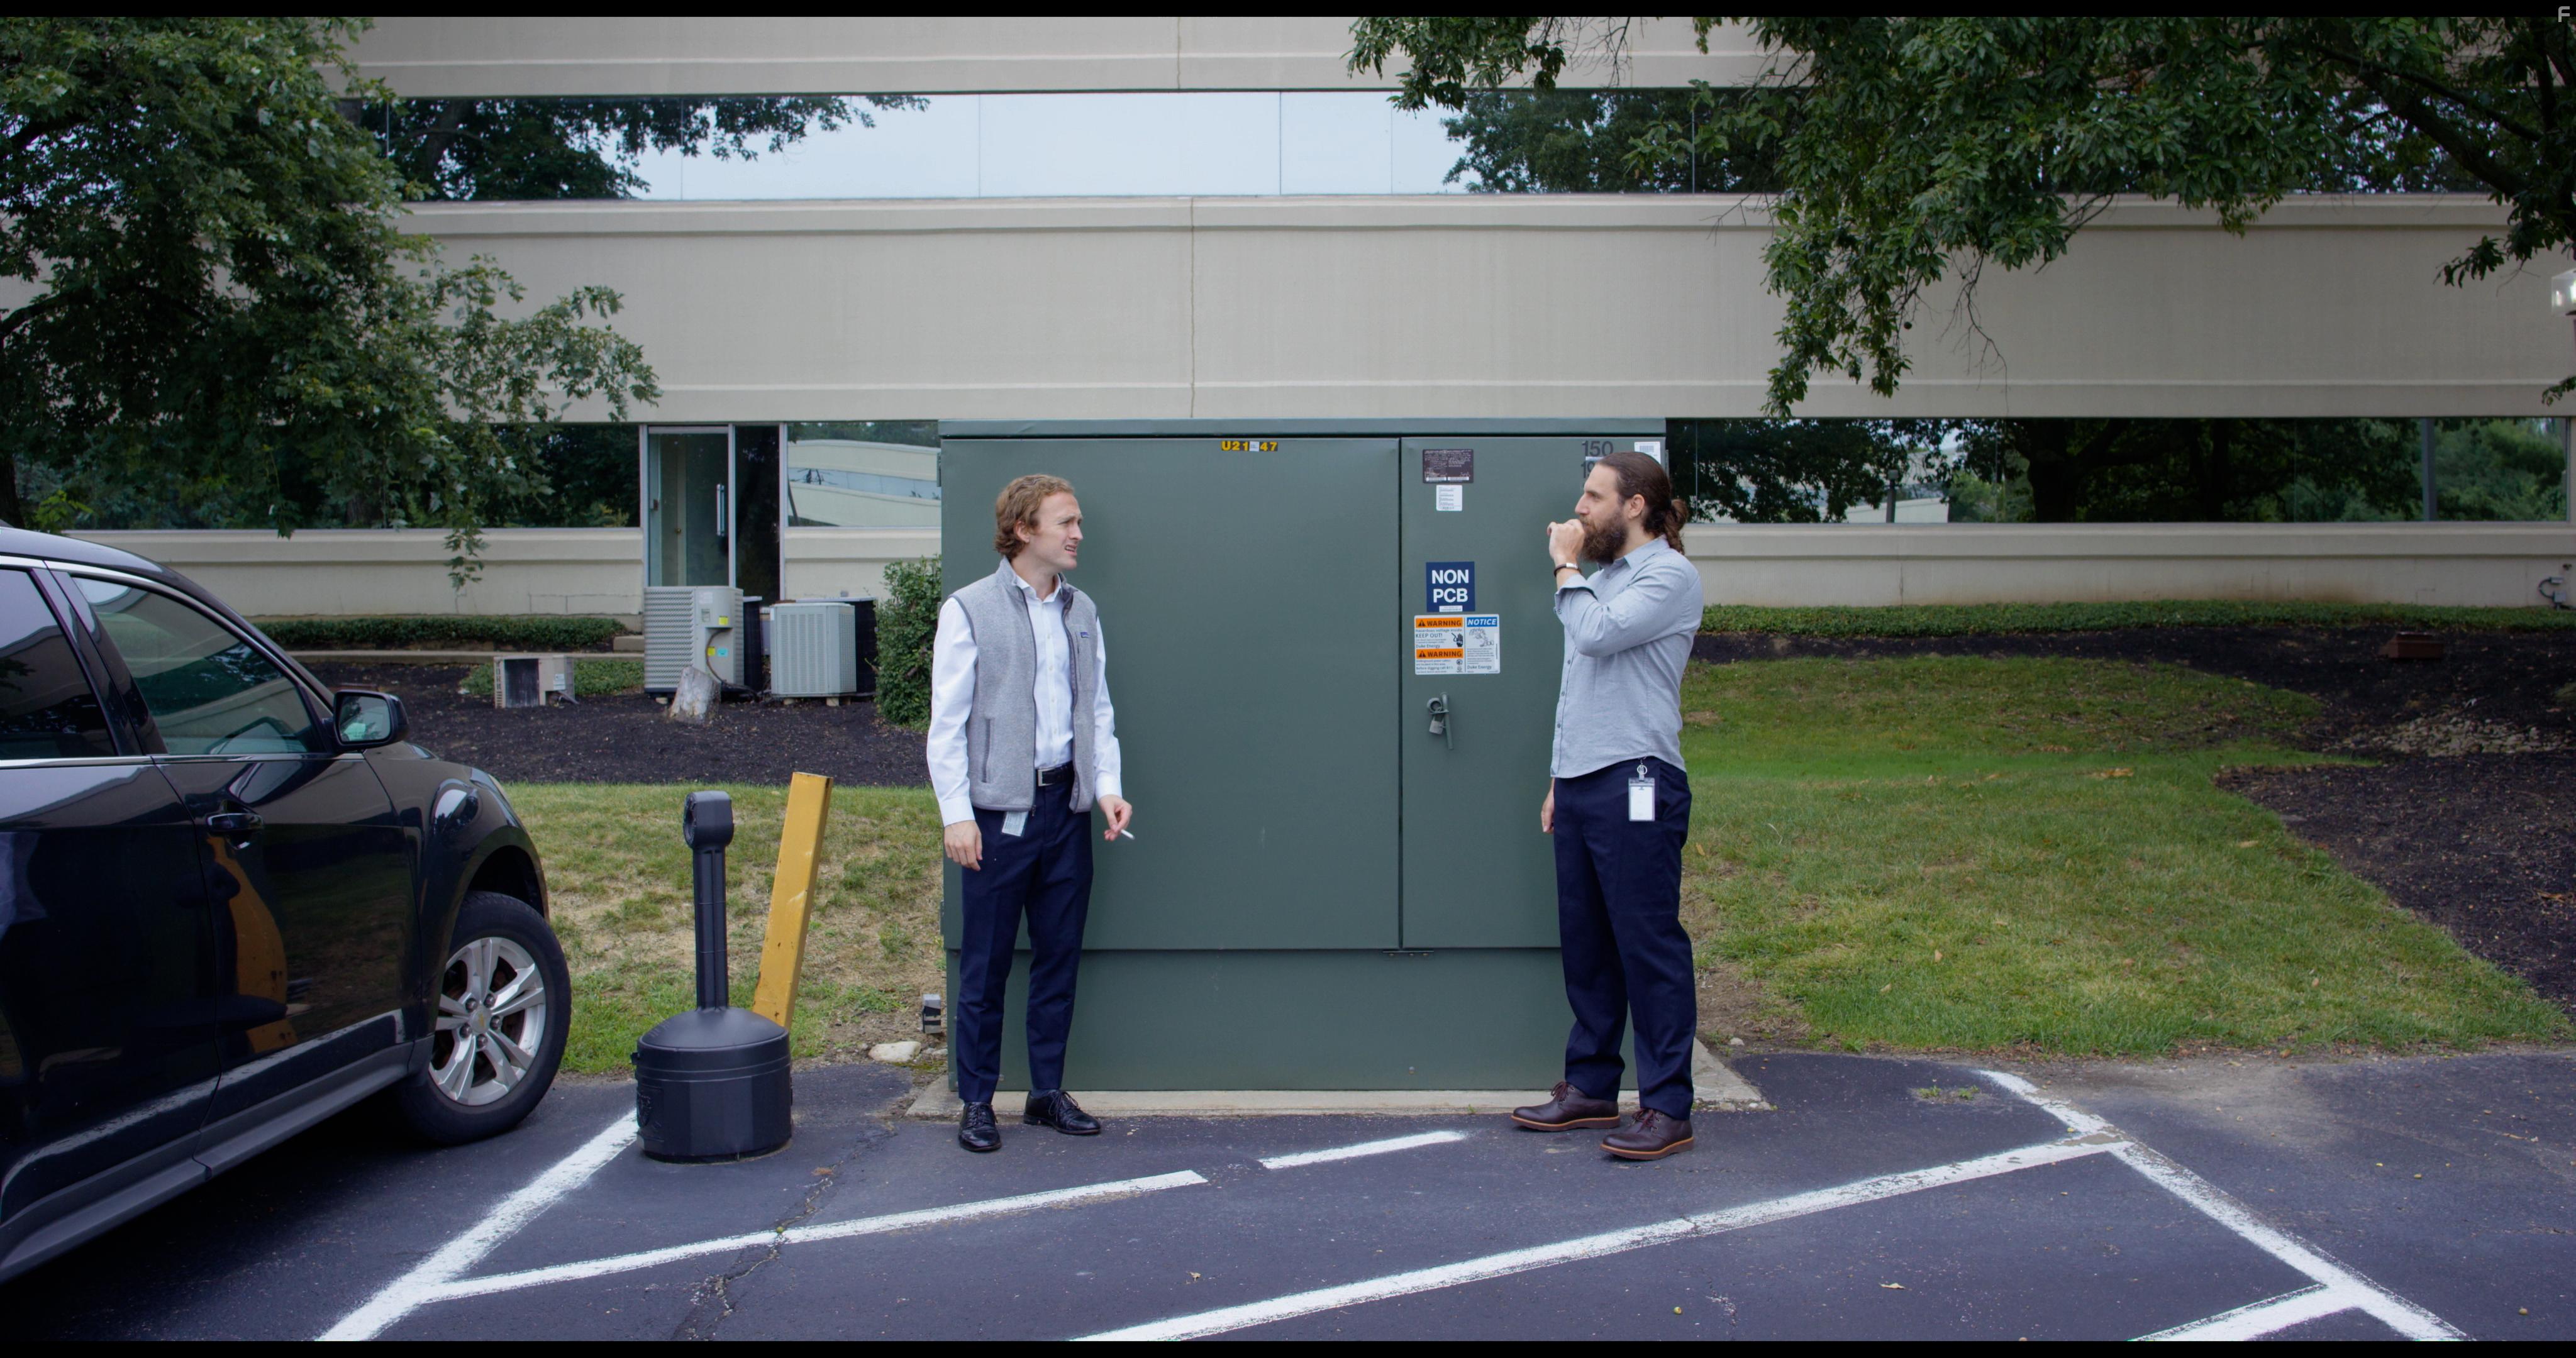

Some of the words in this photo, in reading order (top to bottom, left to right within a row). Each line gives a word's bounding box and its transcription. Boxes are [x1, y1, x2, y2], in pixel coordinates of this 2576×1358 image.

[1582, 441, 1614, 456] 150
[1431, 569, 1469, 584] NON
[1433, 588, 1468, 603] PCB
